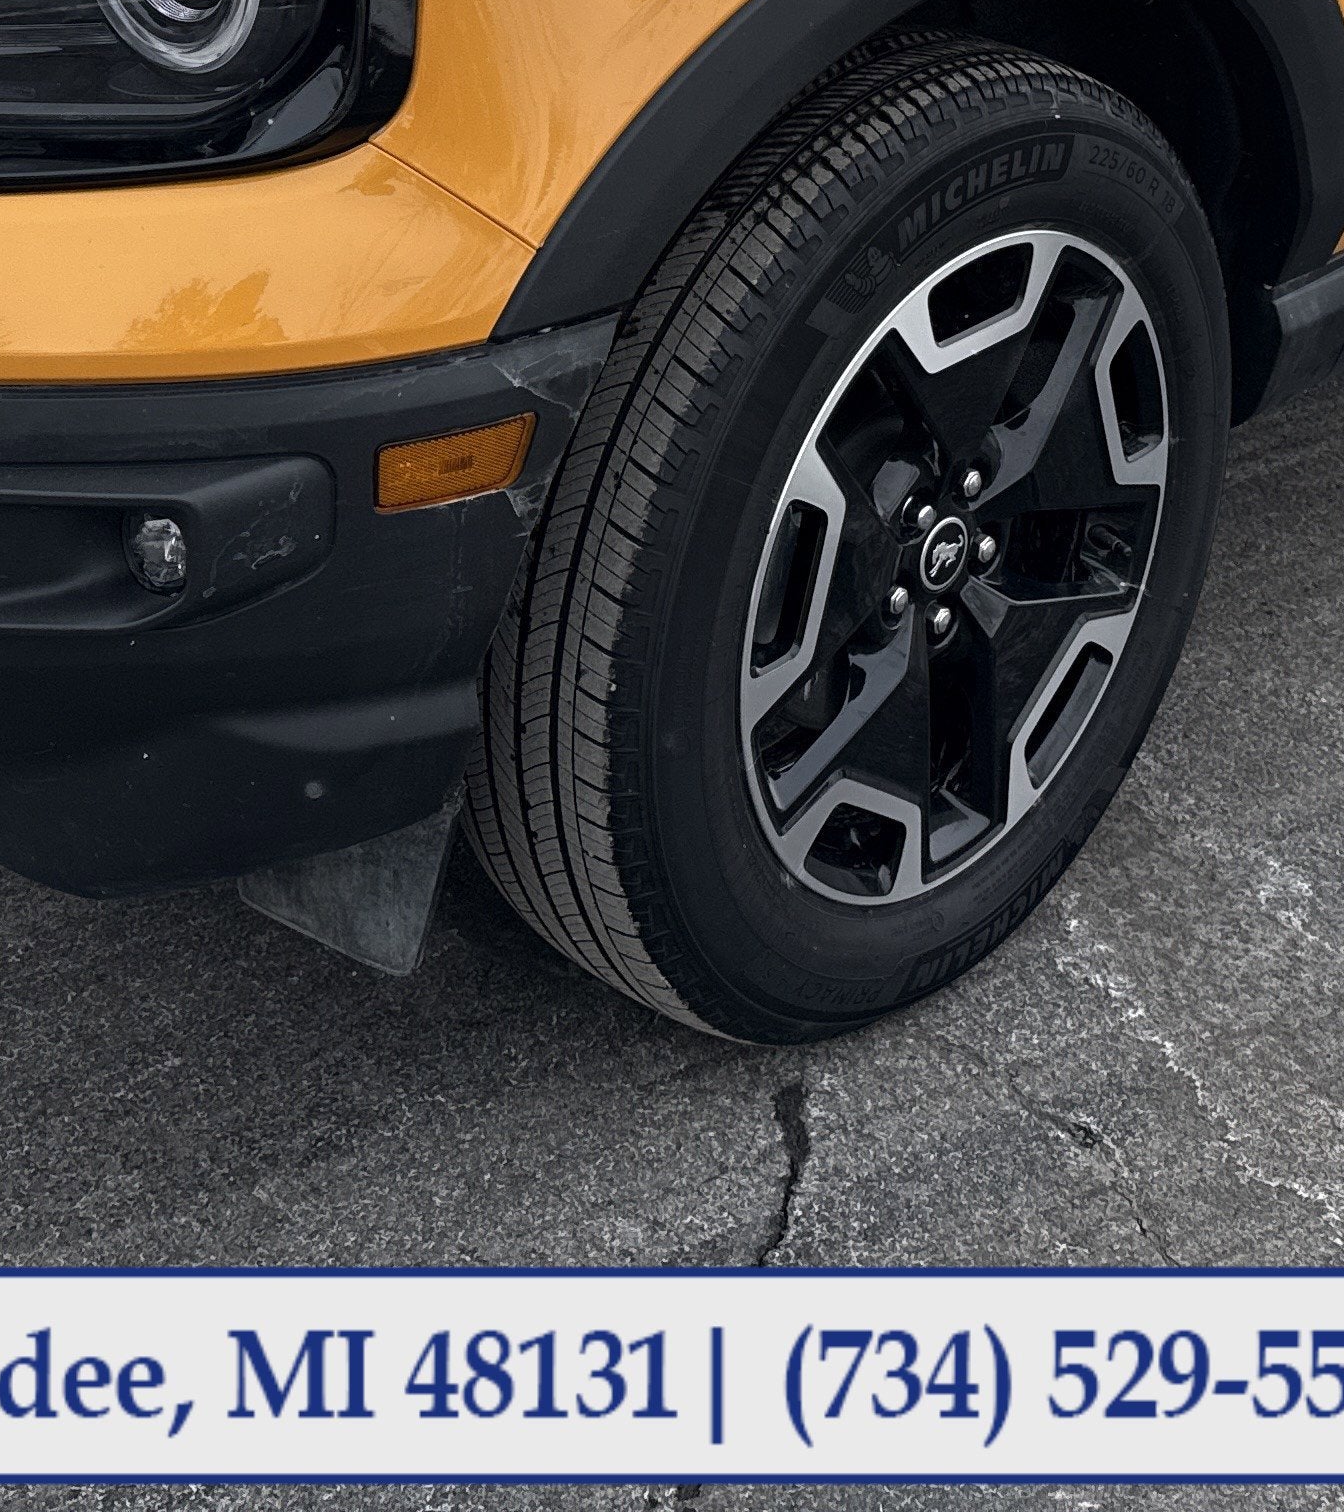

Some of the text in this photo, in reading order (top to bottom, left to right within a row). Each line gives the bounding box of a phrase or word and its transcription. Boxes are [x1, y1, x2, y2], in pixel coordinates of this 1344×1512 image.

[897, 143, 1066, 250] MICHELIN
[1089, 145, 1176, 213] 225/60 R 18
